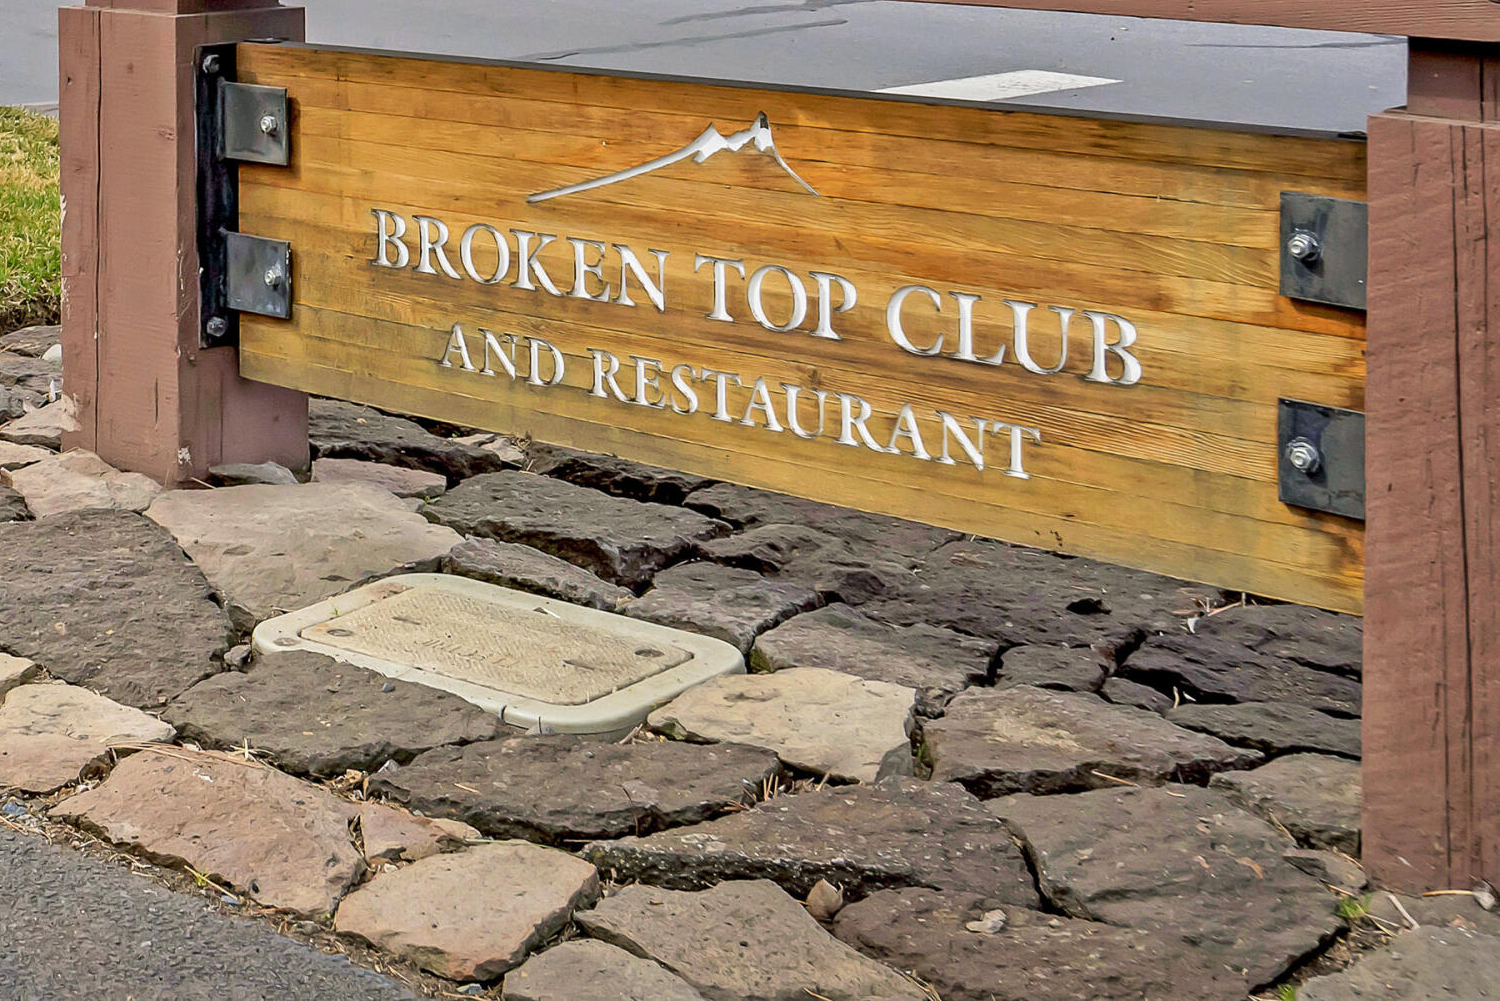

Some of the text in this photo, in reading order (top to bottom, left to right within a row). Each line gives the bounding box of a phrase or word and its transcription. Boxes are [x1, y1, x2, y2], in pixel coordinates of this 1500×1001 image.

[371, 208, 1143, 385] BROKEN TOP CLUB
[439, 322, 1041, 479] AND RESTAURANT
